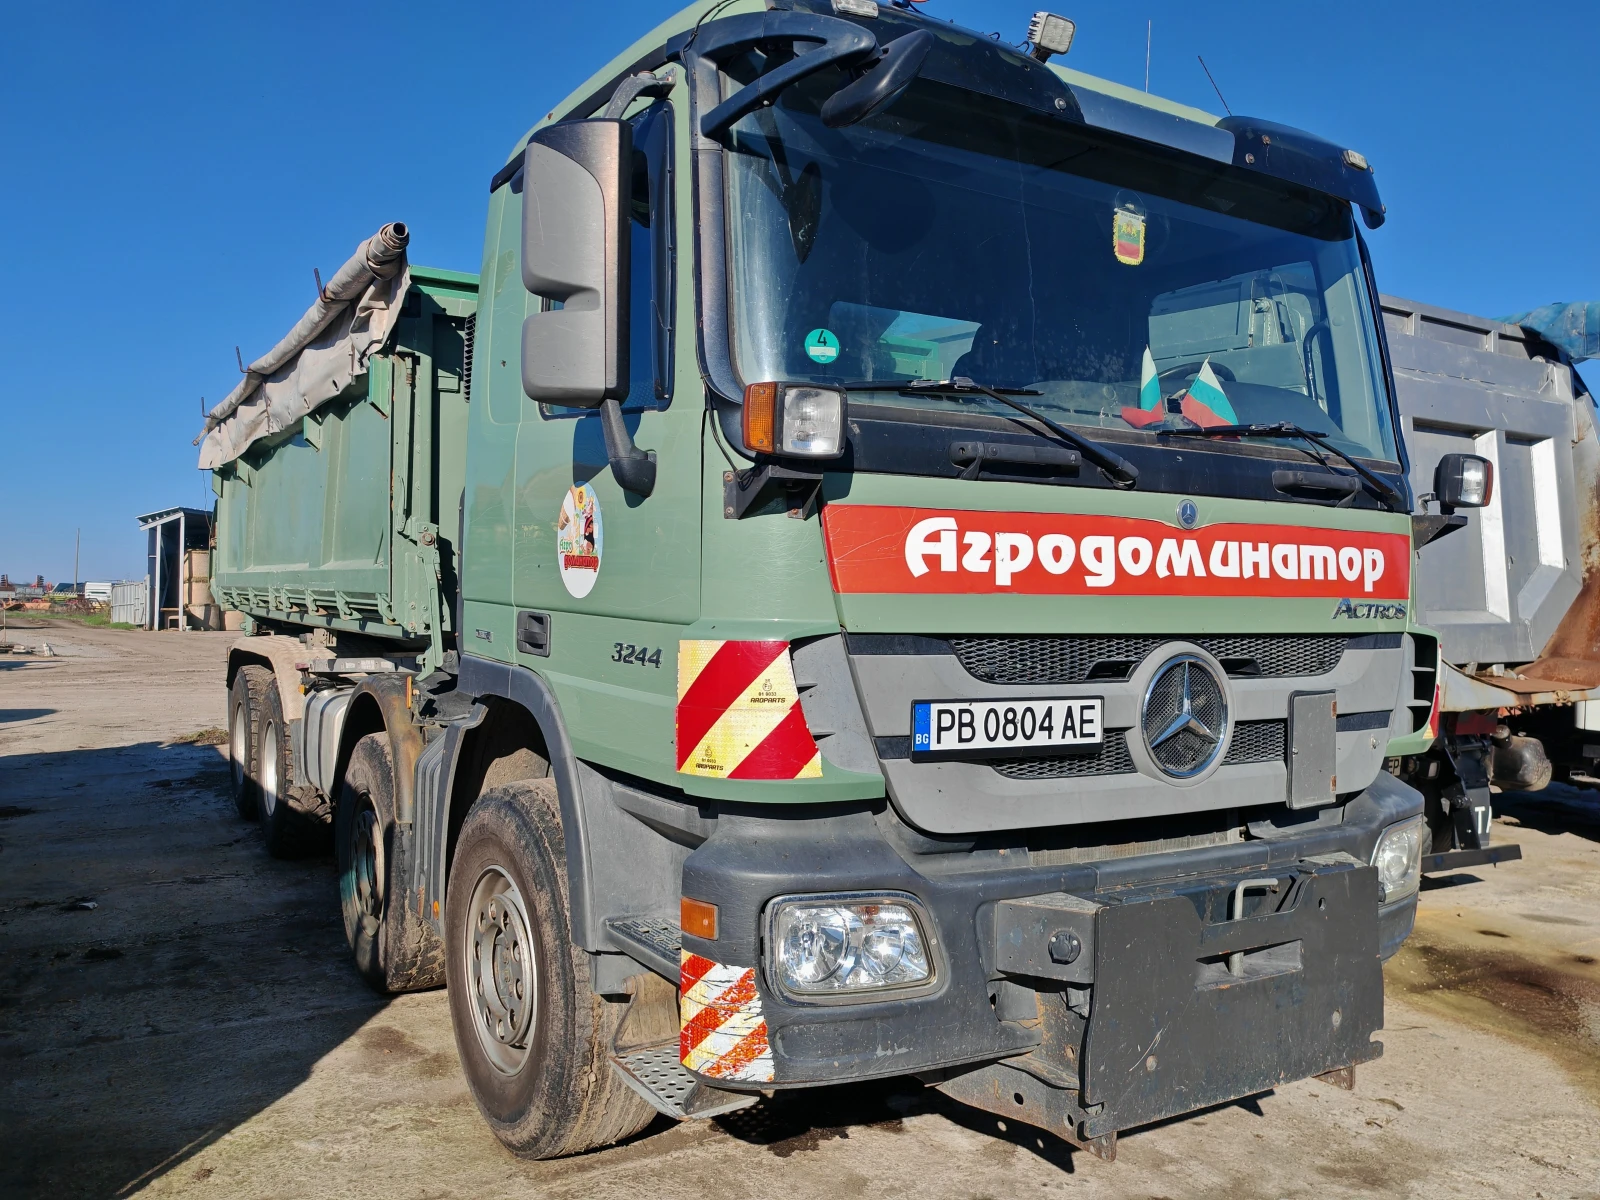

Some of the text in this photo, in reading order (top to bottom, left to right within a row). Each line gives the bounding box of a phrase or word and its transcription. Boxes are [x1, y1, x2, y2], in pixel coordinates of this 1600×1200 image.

[817, 330, 828, 346] 4
[905, 516, 1385, 592] Агродоминатор
[611, 642, 663, 669] 3244
[936, 704, 1096, 744] PB 0804 AE
[915, 733, 929, 745] BG
